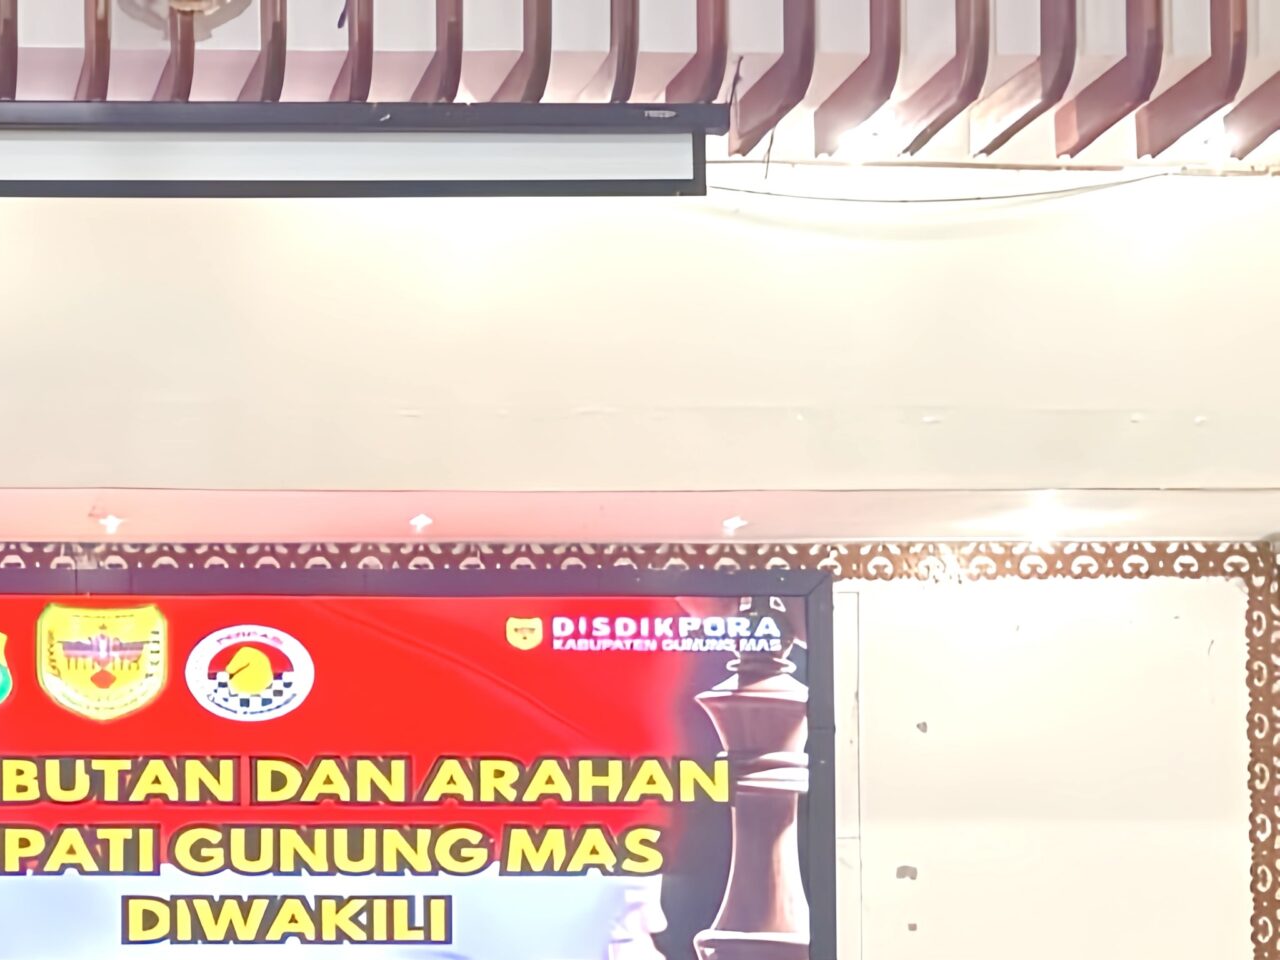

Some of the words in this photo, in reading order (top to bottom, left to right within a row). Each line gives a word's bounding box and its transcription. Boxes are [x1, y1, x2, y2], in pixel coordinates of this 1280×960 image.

[552, 616, 782, 638] DISDIKPORA
[552, 638, 658, 651] KABUPATEN
[739, 638, 783, 652] MAS
[253, 757, 408, 804] DAN
[423, 757, 731, 804] ARAHAN
[172, 826, 490, 875] GUNUNG
[505, 826, 664, 874] MAS
[125, 896, 448, 942] DIWAKILI
